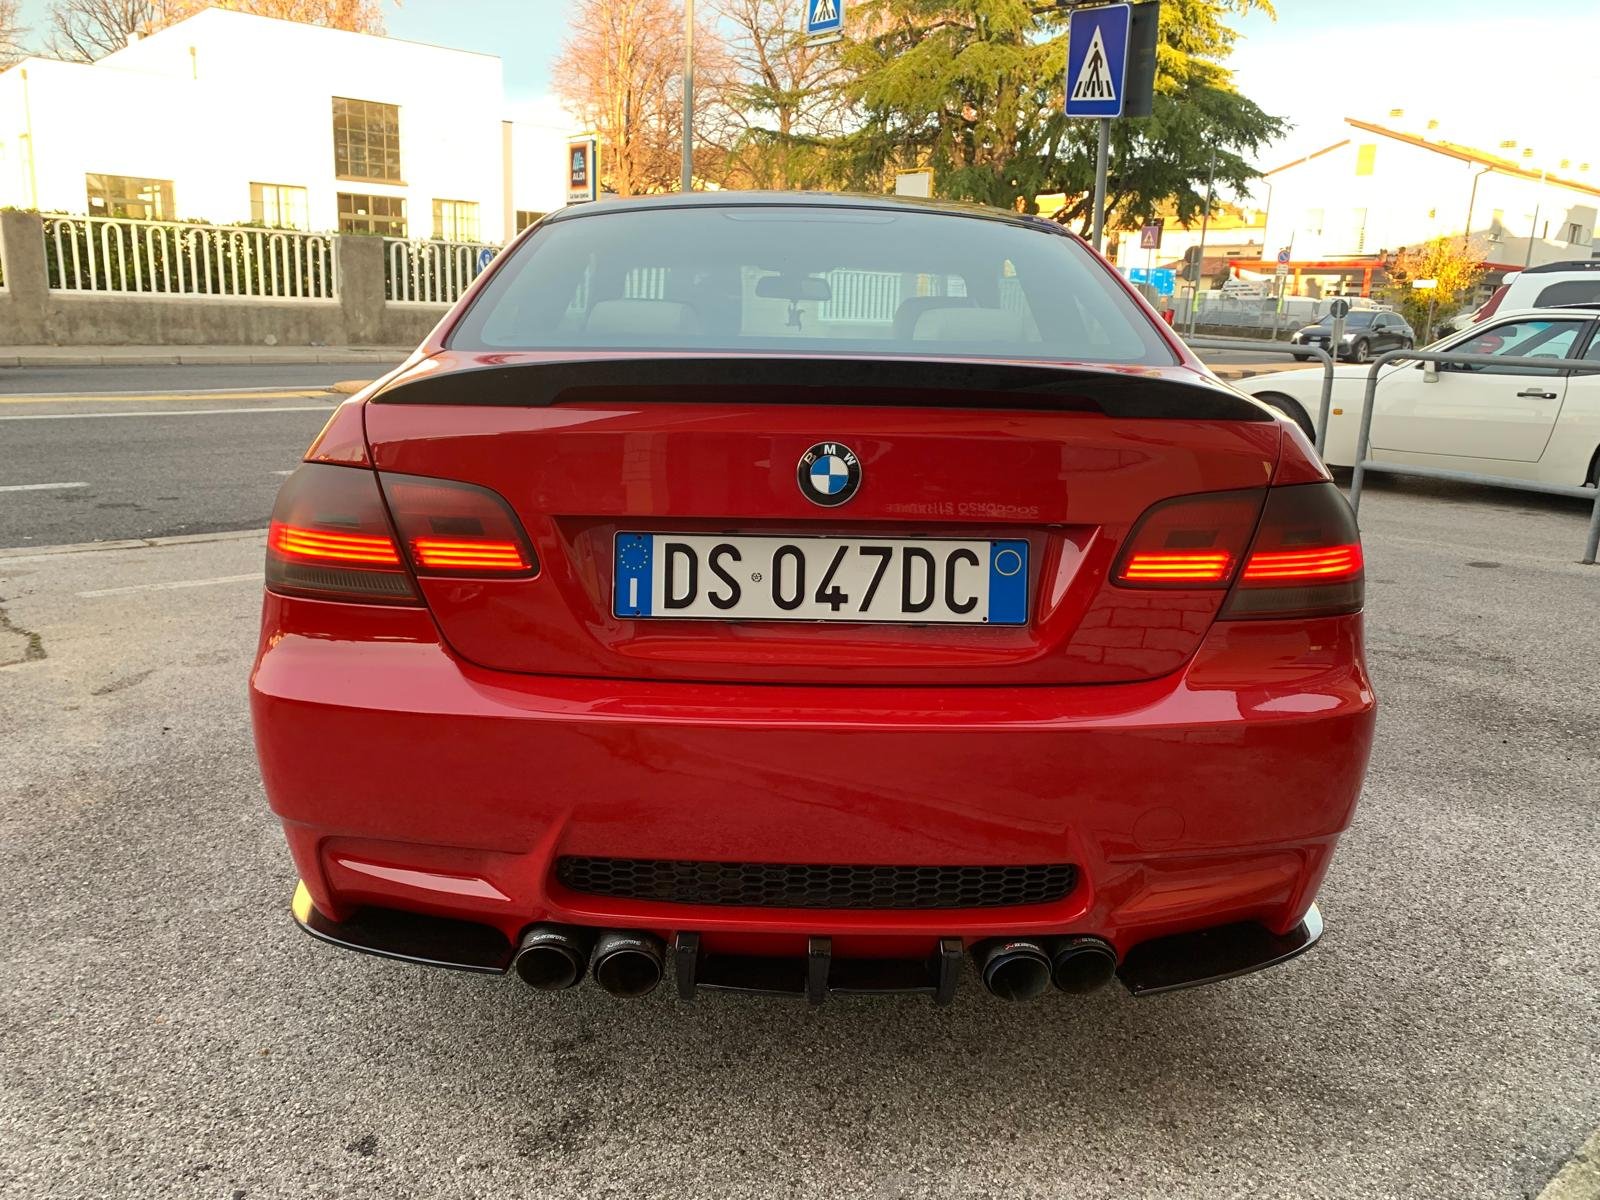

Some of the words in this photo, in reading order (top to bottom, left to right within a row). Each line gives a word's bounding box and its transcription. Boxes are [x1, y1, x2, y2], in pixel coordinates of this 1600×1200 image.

[572, 171, 585, 181] ALDI
[803, 444, 857, 466] BMW
[663, 542, 742, 610] DS
[771, 543, 980, 614] 047DC
